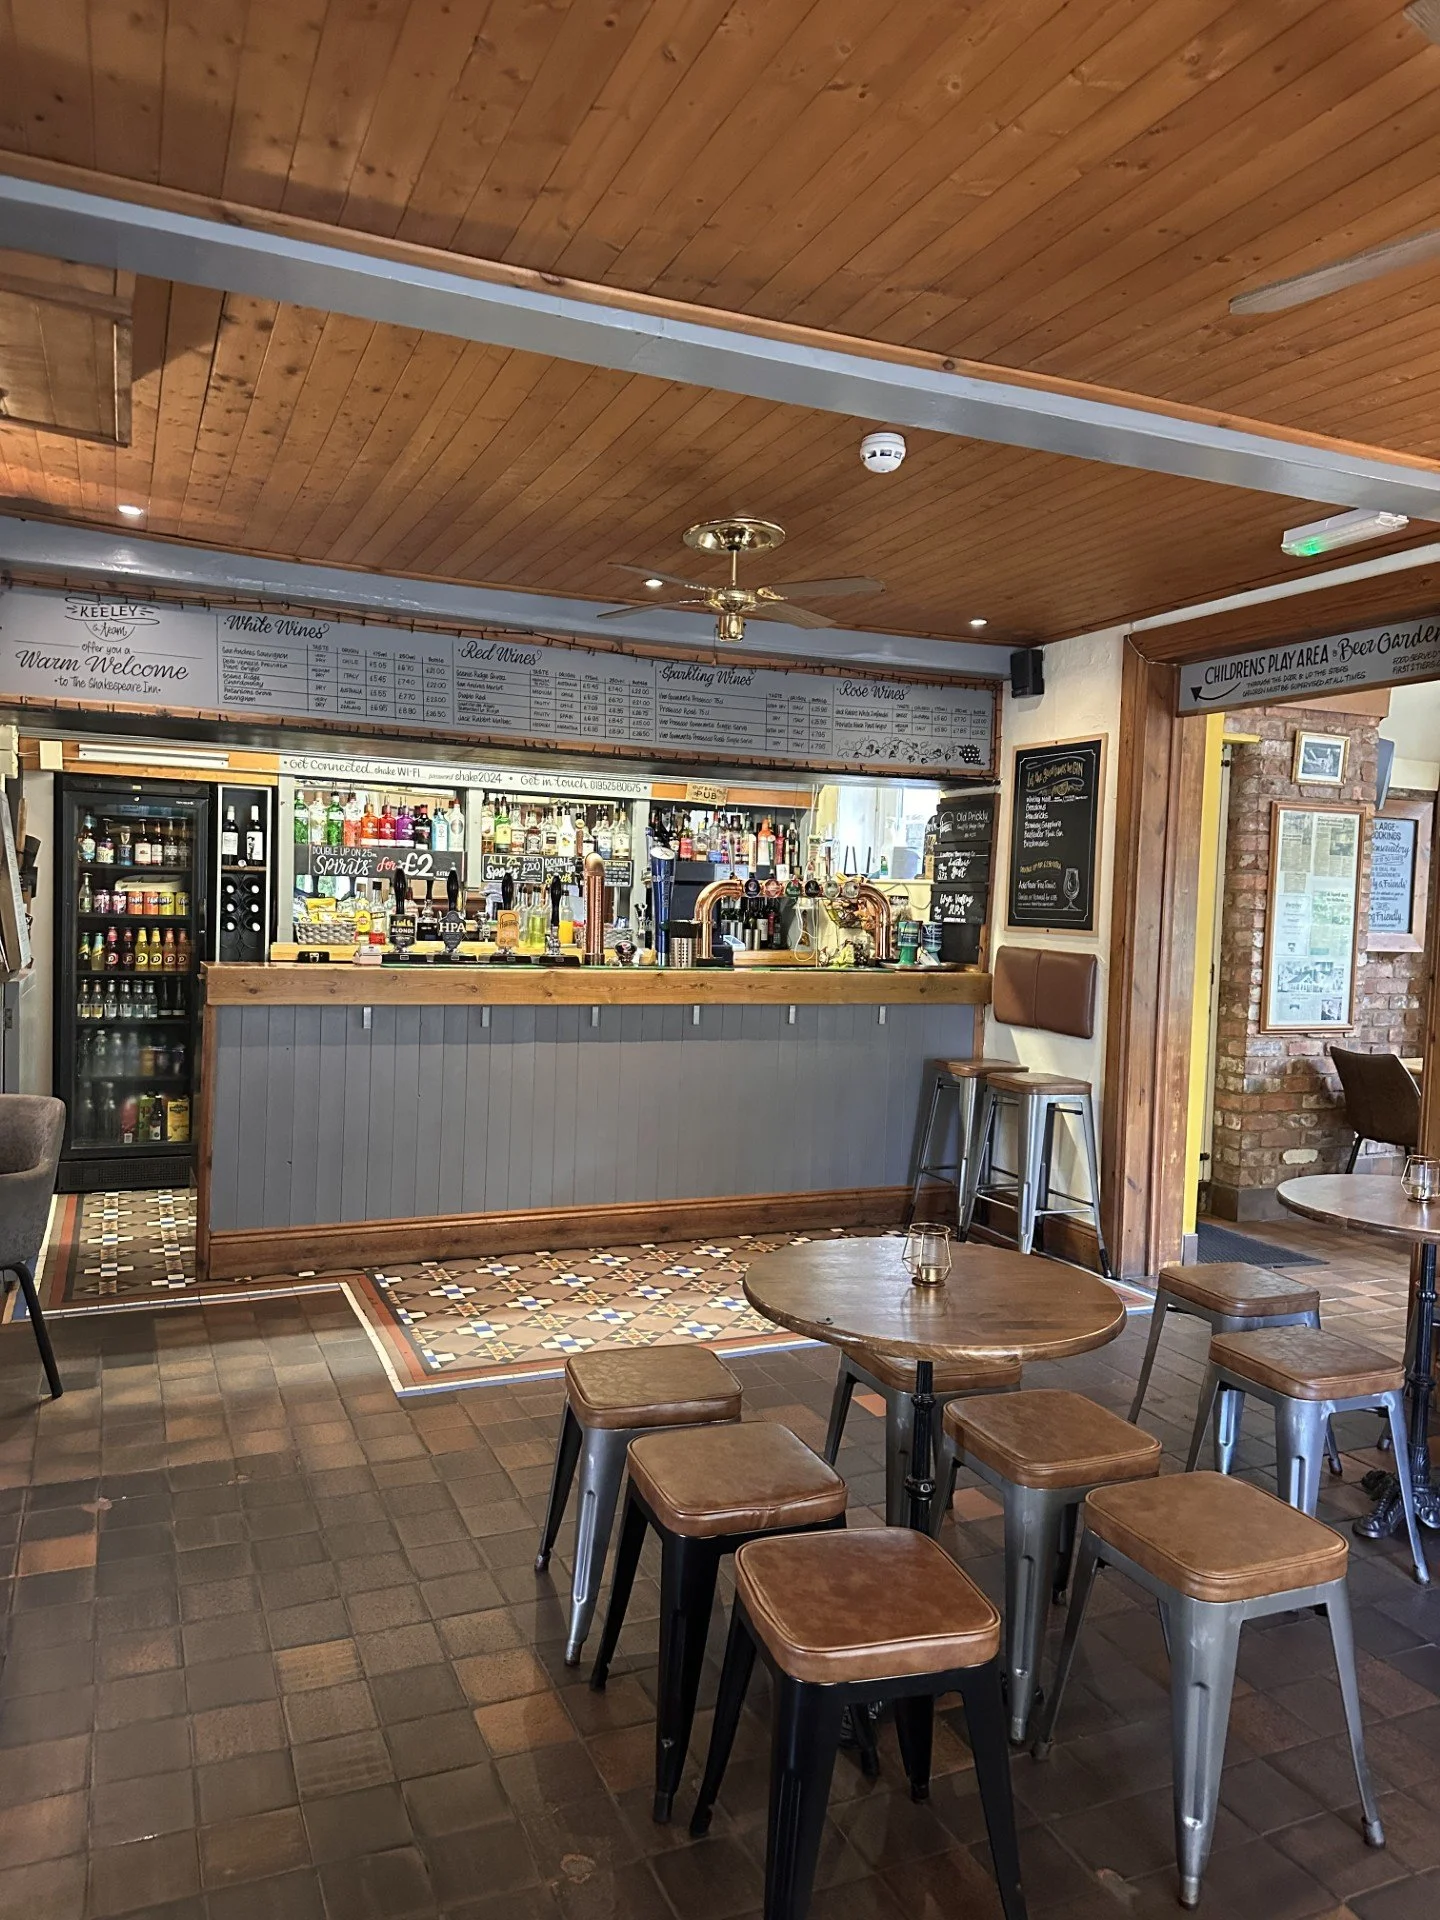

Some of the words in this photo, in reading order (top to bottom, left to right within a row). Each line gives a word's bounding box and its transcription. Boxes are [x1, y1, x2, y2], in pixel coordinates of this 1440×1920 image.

[80, 605, 138, 618] KEELEY
[100, 622, 127, 638] team
[226, 615, 272, 634] White
[274, 619, 329, 639] Wines
[82, 641, 104, 653] offer
[106, 646, 122, 655] you
[460, 640, 497, 661] Red
[496, 646, 542, 666] Wines
[15, 649, 82, 671] Warm
[84, 655, 190, 680] Welcome
[1203, 656, 1266, 686] CHILDRENS
[1267, 649, 1296, 674] PLAY
[1295, 643, 1329, 669] AREA
[1337, 637, 1377, 663] Beer
[661, 665, 715, 688] Sparkling
[717, 670, 755, 686] Wines
[1344, 670, 1367, 682] TIMES
[58, 675, 69, 687] to
[70, 676, 87, 688] The
[88, 678, 142, 694] Shakespeare
[143, 681, 160, 693] Inn
[870, 685, 910, 701] Wines
[289, 757, 311, 769] Get
[310, 759, 370, 774] Connected
[374, 766, 397, 776] shake
[397, 767, 421, 778] WI-FI
[455, 770, 503, 784] shake2024
[520, 773, 539, 787] Get
[542, 776, 555, 787] in
[556, 775, 588, 788] touch
[696, 789, 717, 800] PUB
[956, 811, 968, 822] Old
[1371, 830, 1402, 842] OOKINGS
[312, 845, 340, 856] DOUBLE
[340, 846, 351, 857] UP
[350, 847, 362, 857] ON
[312, 854, 373, 877] Spirits
[376, 855, 398, 873] for
[403, 852, 434, 878] £2
[487, 855, 506, 866] ALL
[545, 857, 573, 867] DOUBLE
[391, 927, 415, 935] BLONDE
[439, 922, 467, 934] HPA
